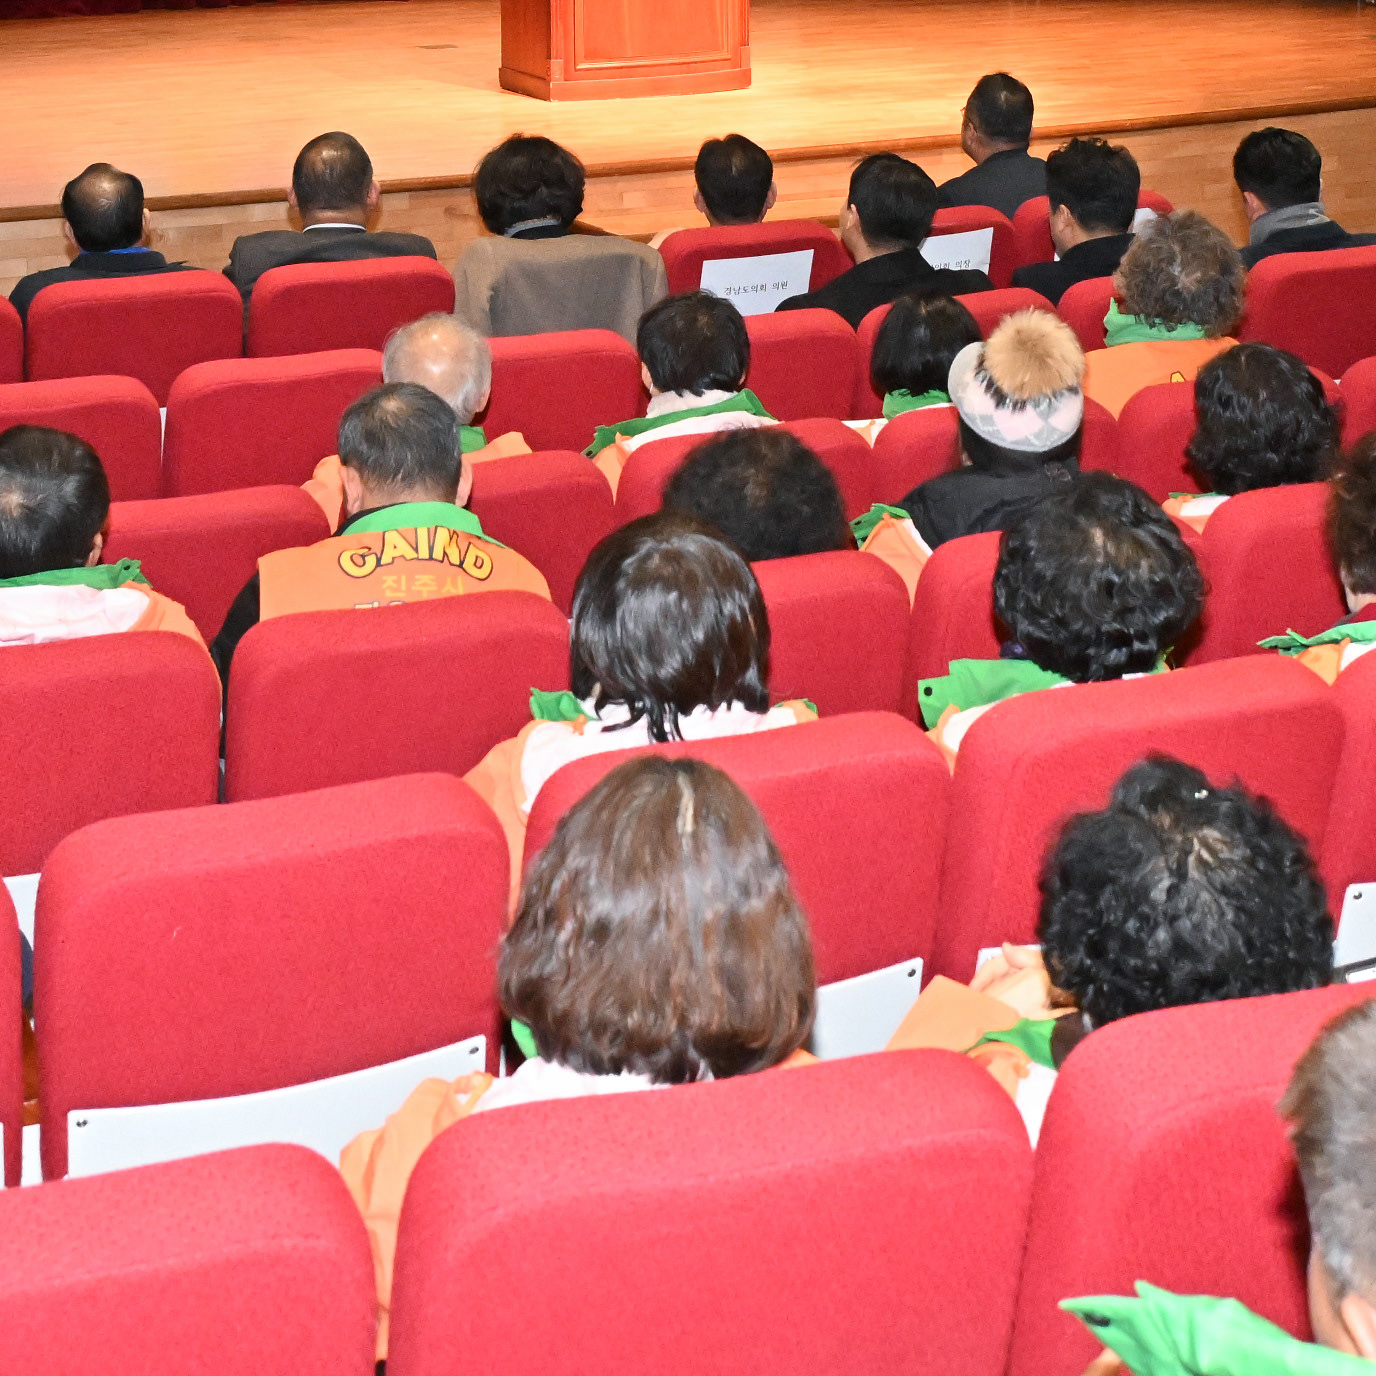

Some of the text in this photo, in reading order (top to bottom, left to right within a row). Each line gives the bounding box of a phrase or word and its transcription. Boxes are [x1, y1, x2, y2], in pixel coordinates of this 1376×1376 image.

[723, 282, 767, 296] 경남도의회
[337, 525, 494, 582] GAIND
[380, 574, 466, 599] 진주시
